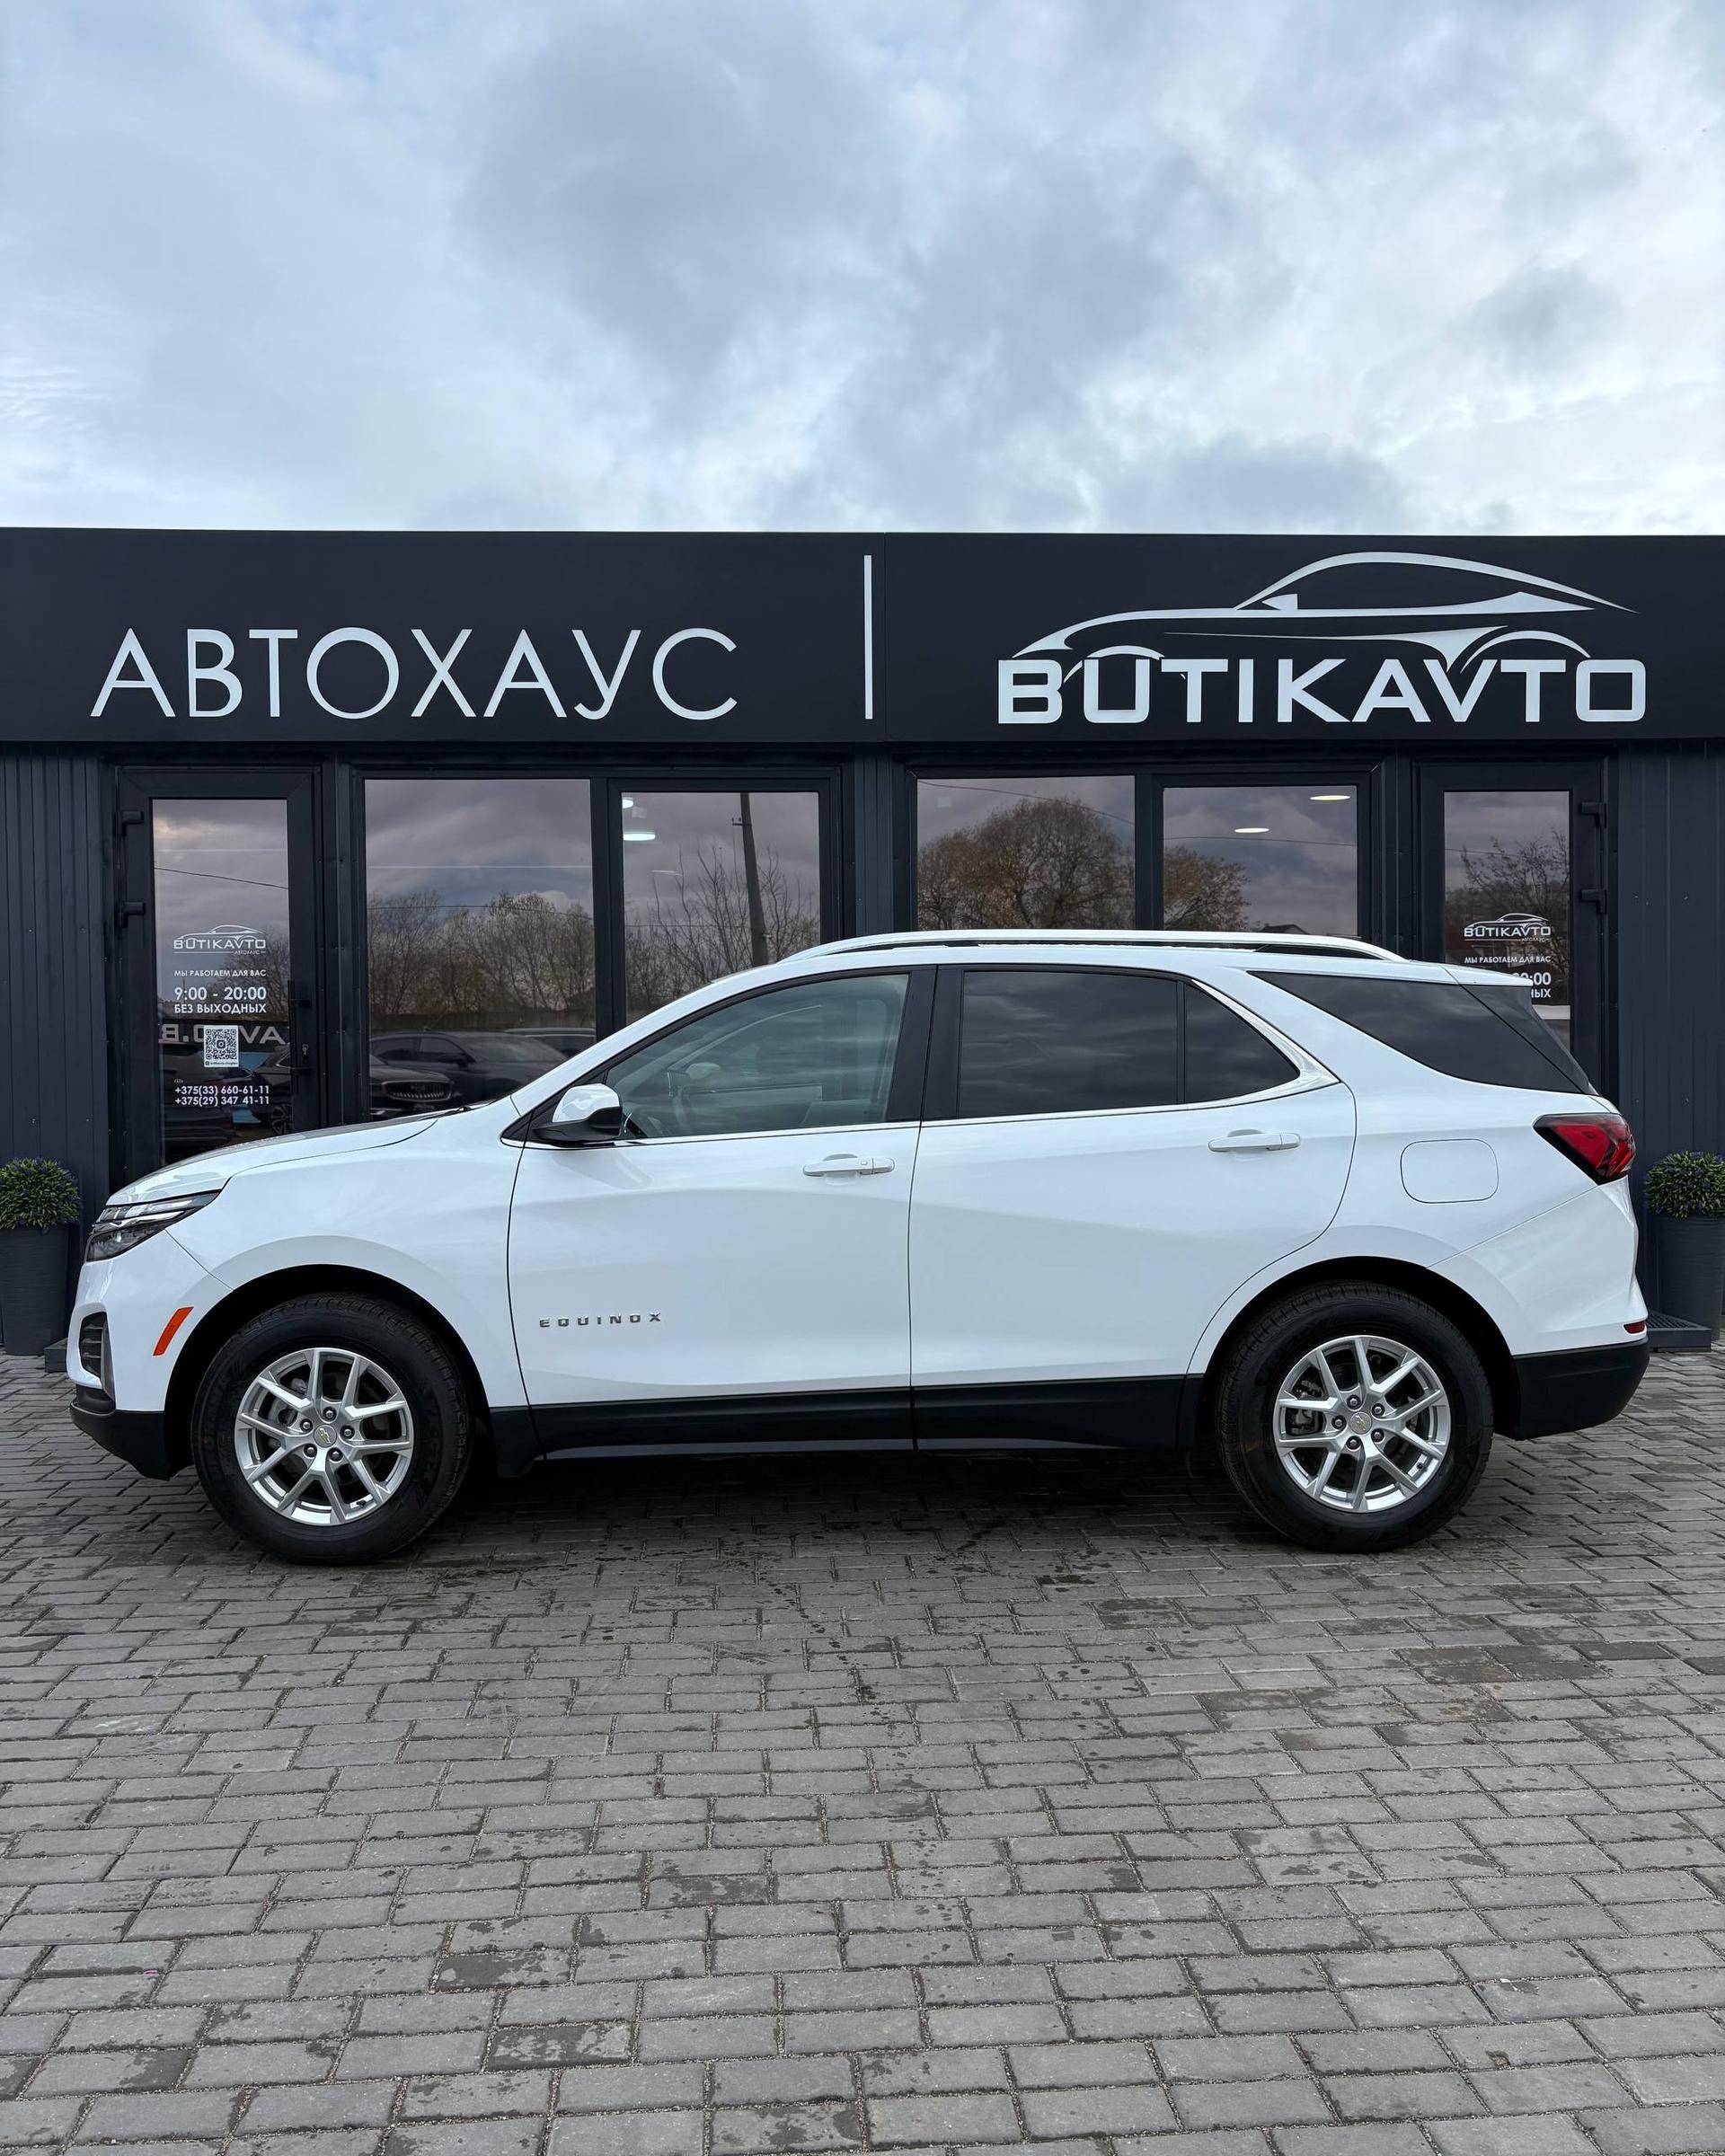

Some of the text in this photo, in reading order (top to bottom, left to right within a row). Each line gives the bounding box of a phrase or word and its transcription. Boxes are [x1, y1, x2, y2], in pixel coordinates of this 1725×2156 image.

[91, 628, 738, 720] АВТОХАУС
[998, 658, 1646, 723] BUTIKAVTO
[1464, 927, 1551, 937] BUTIKAVTO
[173, 940, 266, 950] BUTIKAVTO
[1479, 956, 1517, 964] РАБОТАЕМ
[1535, 955, 1552, 963] ВАС
[190, 969, 231, 977] РАБОТАЕМ
[232, 969, 248, 977] ДЛЯ
[174, 986, 208, 1001] 9:00
[224, 986, 267, 1001] 20:00
[174, 1003, 267, 1014] БЕЗ ВЫХОДНЫХ
[174, 1085, 270, 1096] +375(33) 660-61-11
[174, 1096, 218, 1107] +375(29)
[221, 1096, 238, 1105] 347
[539, 1312, 661, 1328] EQUINOX
